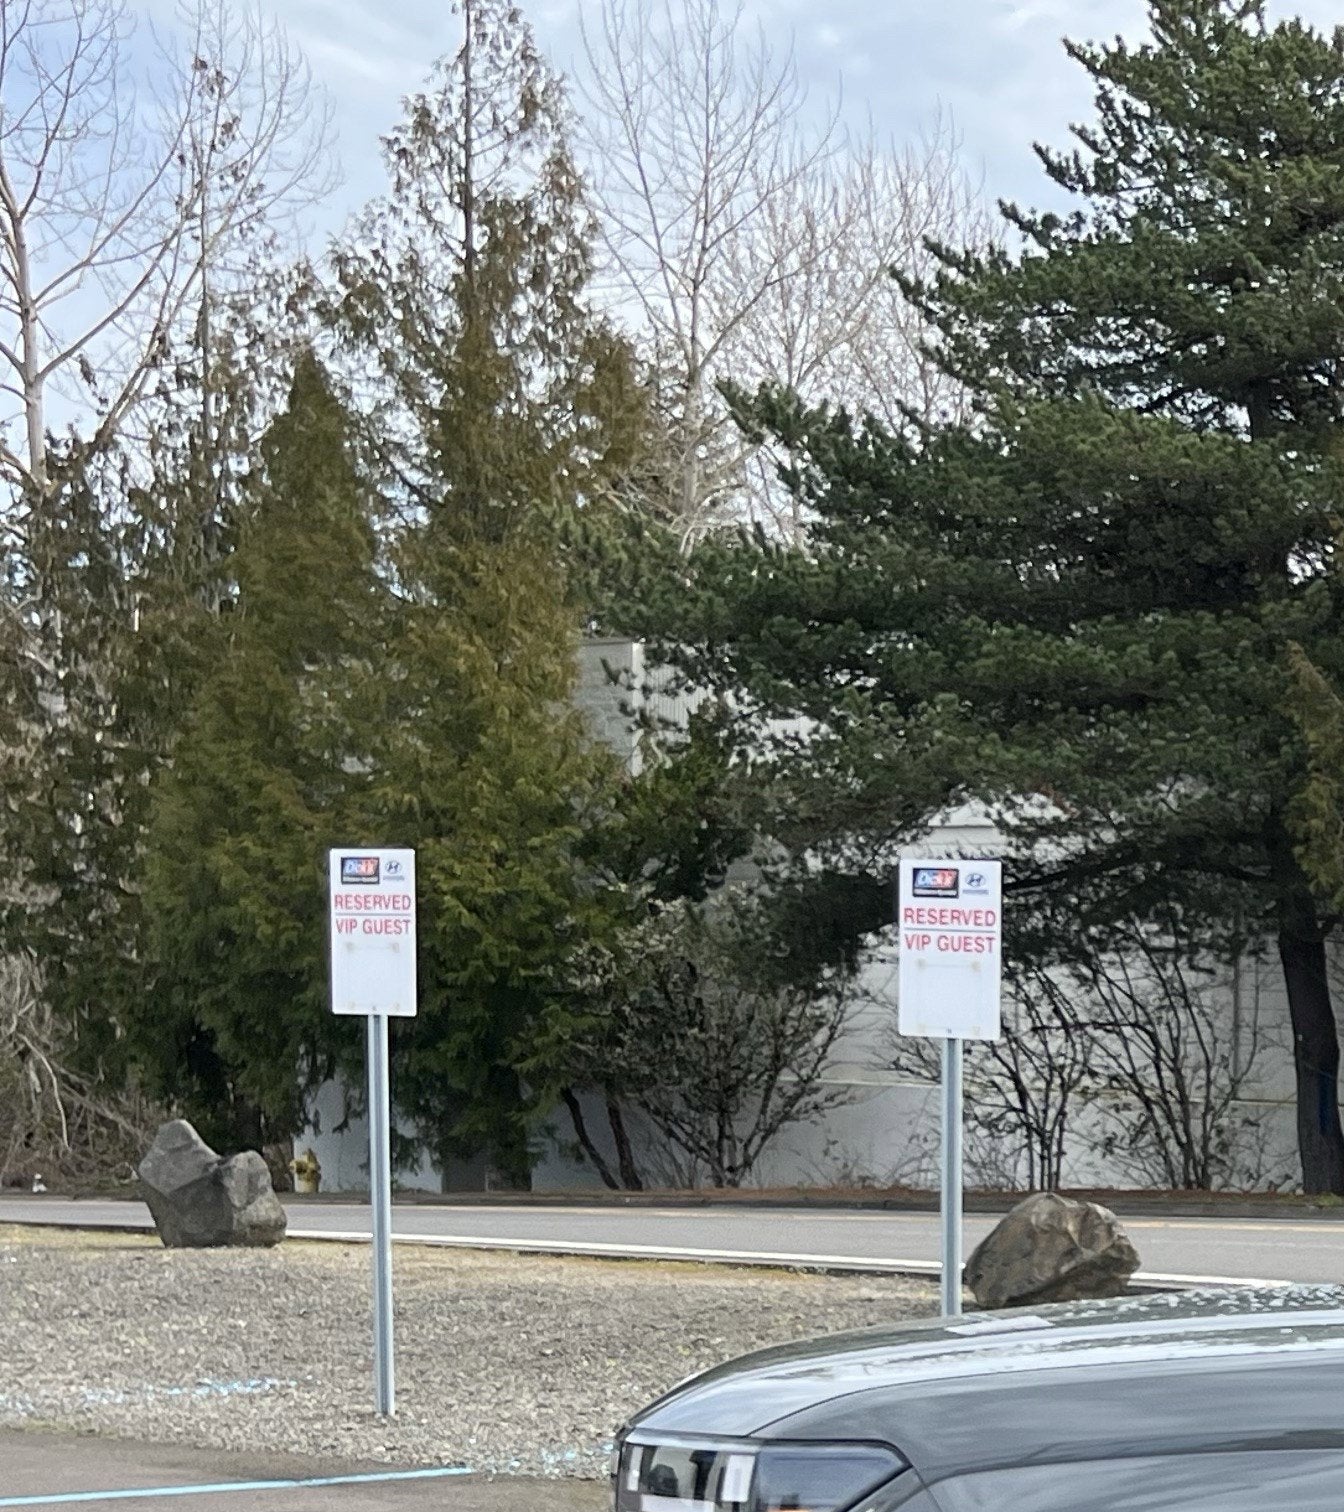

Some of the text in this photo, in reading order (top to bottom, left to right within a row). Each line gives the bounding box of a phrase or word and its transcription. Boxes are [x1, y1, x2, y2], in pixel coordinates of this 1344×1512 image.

[334, 894, 411, 911] RESERVED
[904, 907, 996, 927] RESERVED
[336, 918, 411, 935] VIP GUEST
[904, 934, 996, 953] VIP GUEST
